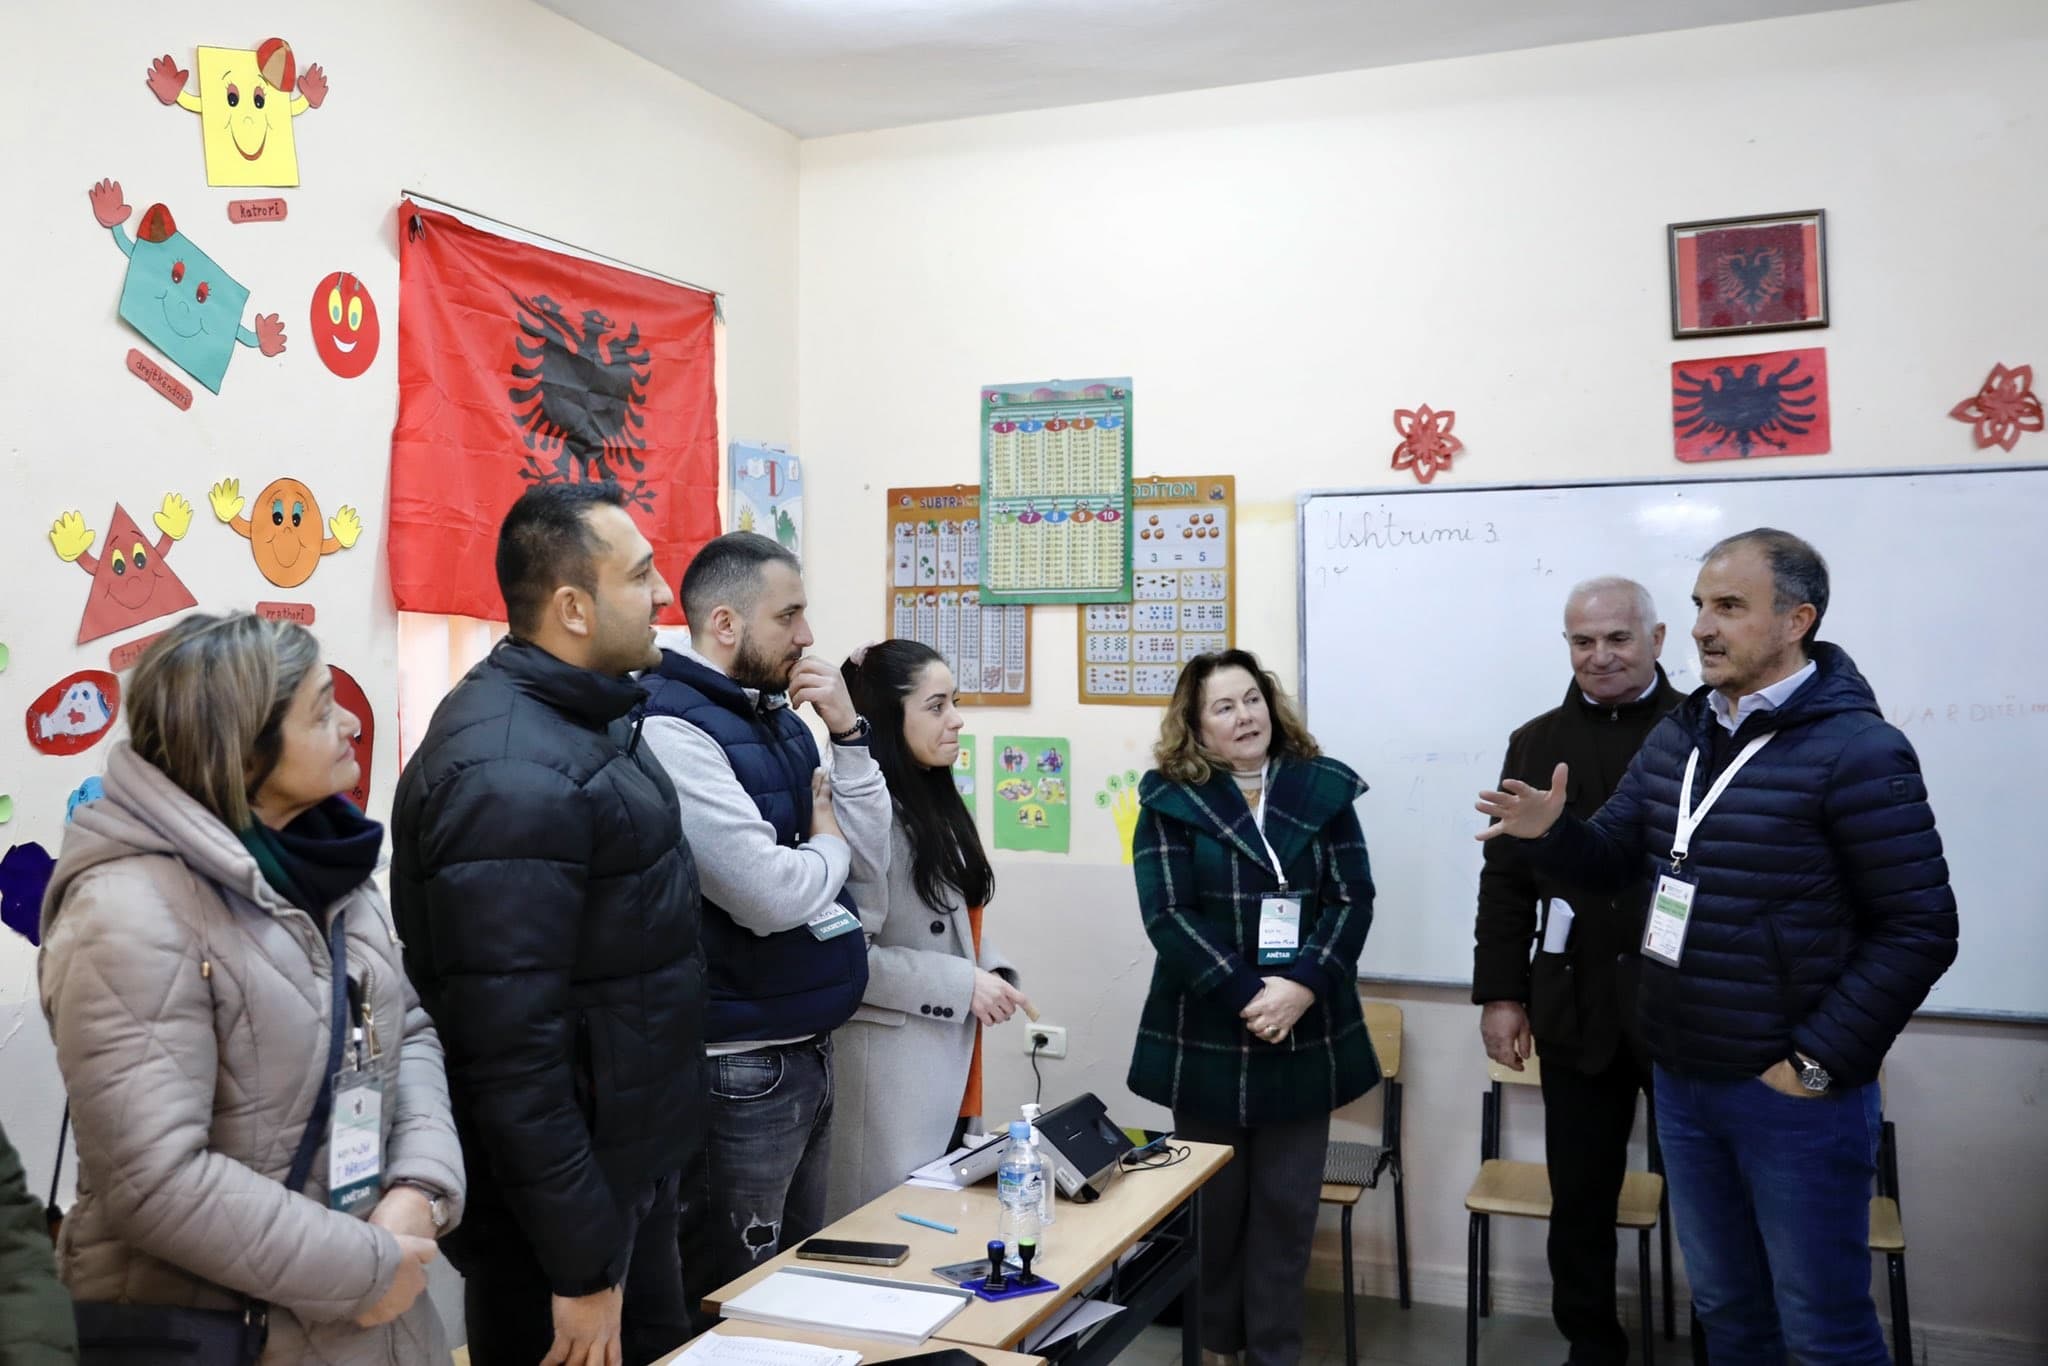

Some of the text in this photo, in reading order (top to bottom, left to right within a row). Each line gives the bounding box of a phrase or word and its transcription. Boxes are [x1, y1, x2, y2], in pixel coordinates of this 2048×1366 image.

[239, 202, 280, 218] katrori
[1001, 424, 1008, 433] 1
[1027, 423, 1034, 431] 2
[1053, 421, 1060, 430] 3
[1079, 420, 1086, 429] 4
[1131, 482, 1197, 498] DDITION
[1026, 512, 1034, 521] 7
[1052, 512, 1059, 521] 8
[1078, 512, 1086, 521] 9
[1101, 511, 1115, 520] 10
[1324, 509, 1501, 549] Ushtrimi 3
[1151, 553, 1158, 563] 3
[1199, 551, 1206, 562] 5
